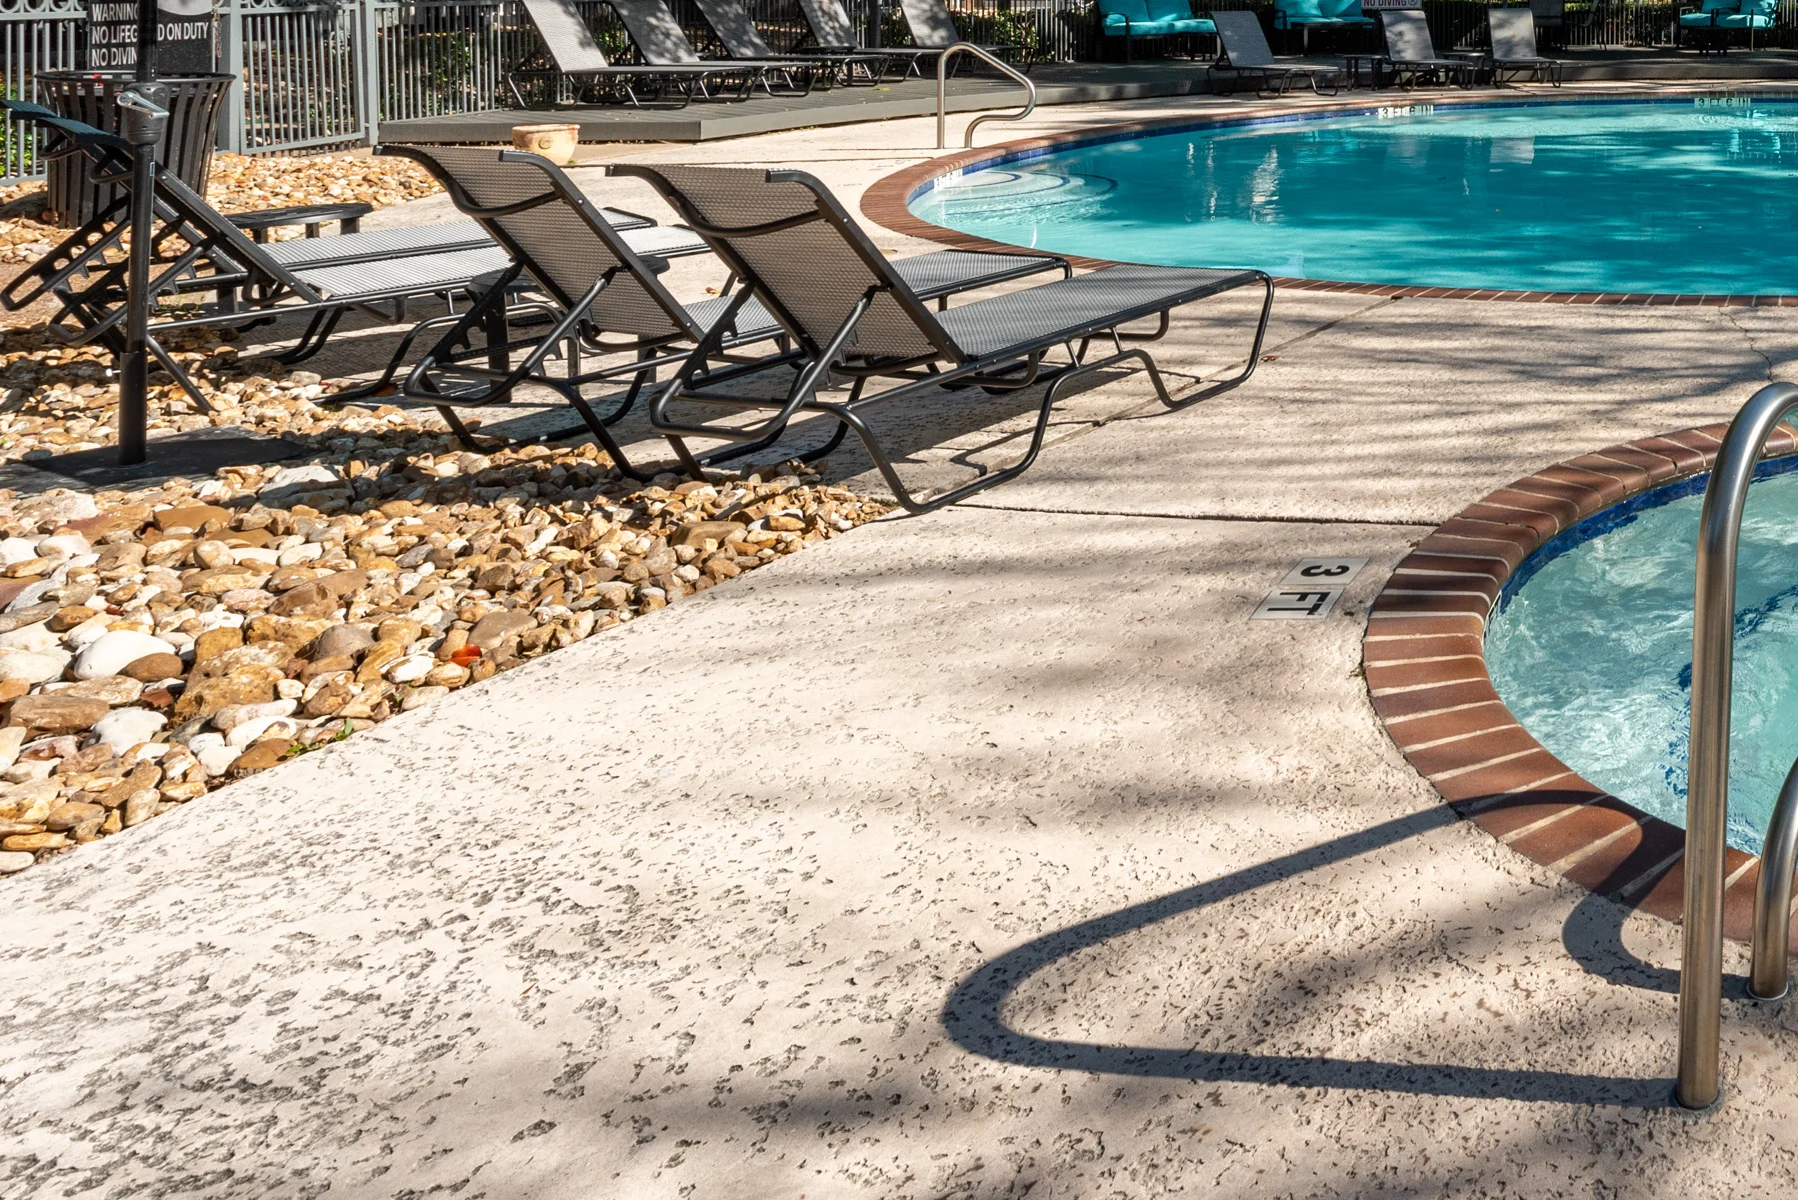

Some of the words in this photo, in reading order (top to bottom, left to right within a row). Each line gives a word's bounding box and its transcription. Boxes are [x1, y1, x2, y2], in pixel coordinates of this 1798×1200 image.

[92, 25, 108, 45] NO
[167, 23, 182, 40] ON
[184, 22, 209, 40] DUTY
[92, 48, 108, 67] NO
[1300, 565, 1350, 577] 3
[1266, 591, 1332, 616] FT
